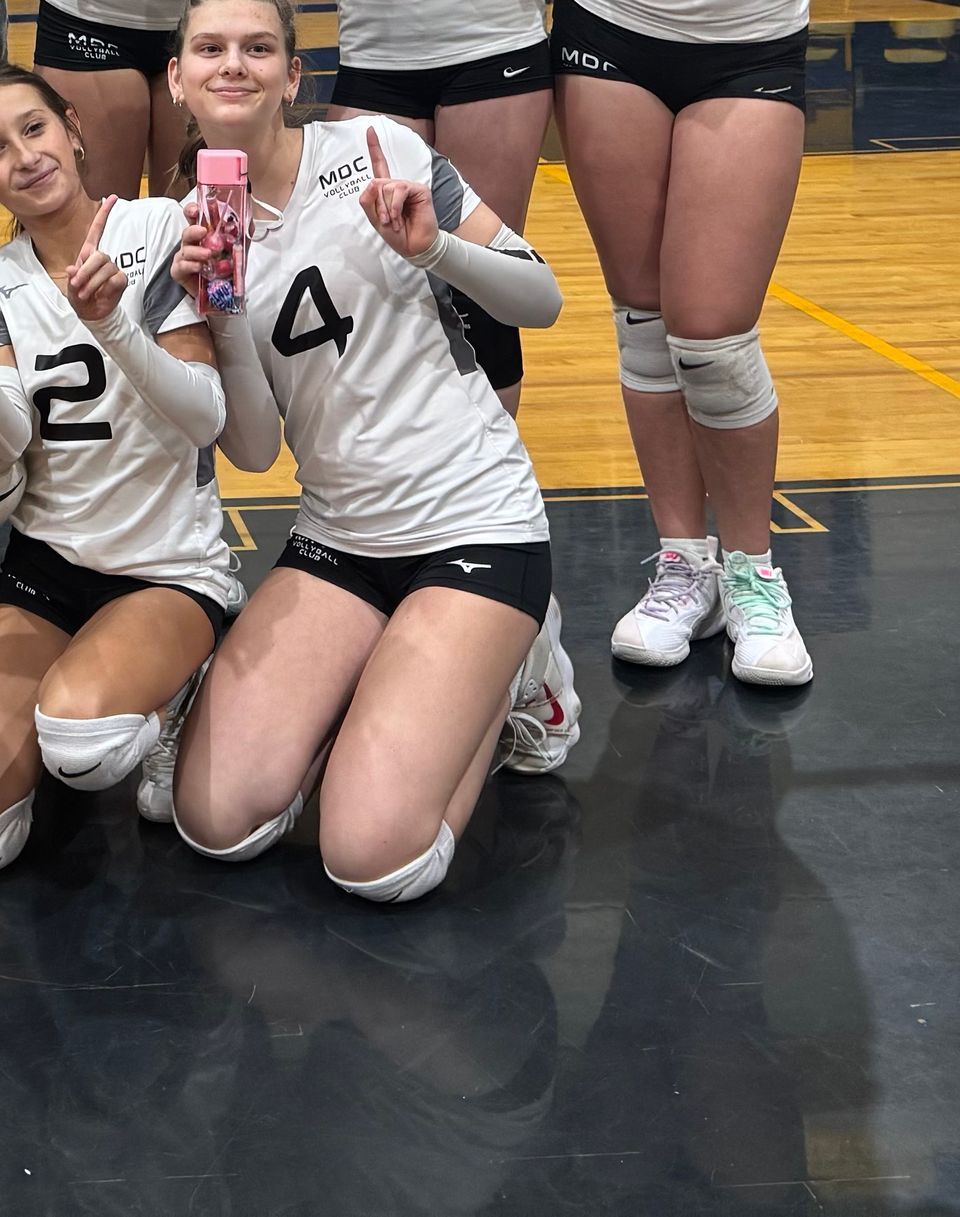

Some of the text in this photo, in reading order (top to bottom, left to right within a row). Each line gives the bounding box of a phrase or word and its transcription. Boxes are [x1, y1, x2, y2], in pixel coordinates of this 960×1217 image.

[84, 51, 107, 61] CLUB
[318, 155, 368, 190] MDC
[323, 173, 372, 198] VOLLYBALL
[114, 246, 146, 269] DC
[272, 265, 354, 358] 4
[33, 344, 113, 441] 2
[298, 548, 321, 562] CLUB
